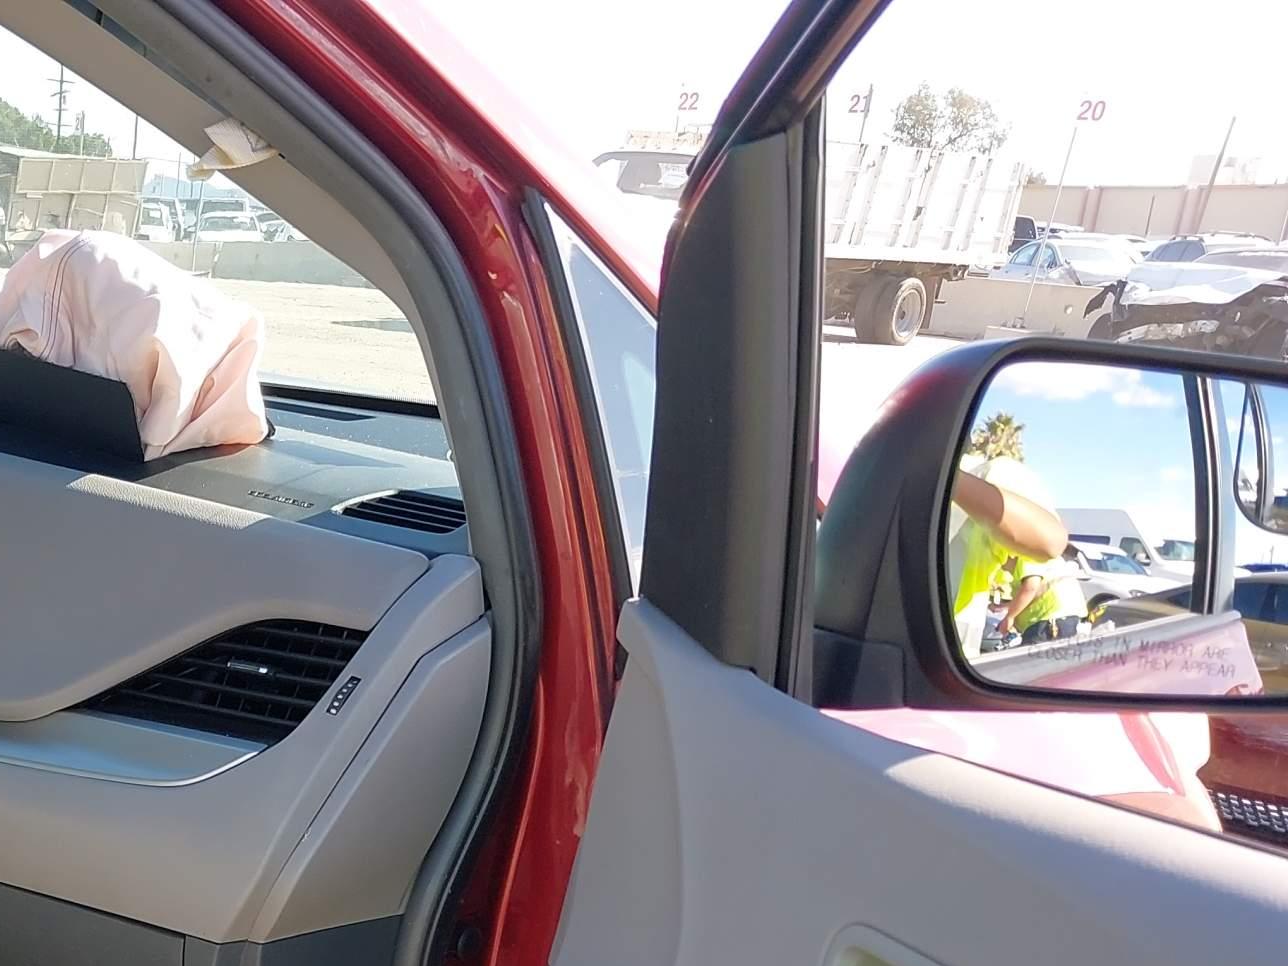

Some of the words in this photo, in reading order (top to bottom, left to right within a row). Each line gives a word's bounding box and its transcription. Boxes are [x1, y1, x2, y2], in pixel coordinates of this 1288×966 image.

[678, 92, 699, 110] 22
[848, 94, 870, 113] 21
[1076, 100, 1106, 121] 20
[1202, 645, 1229, 660] ARE
[1136, 655, 1174, 672] THEY
[1181, 660, 1236, 679] APPEAR
